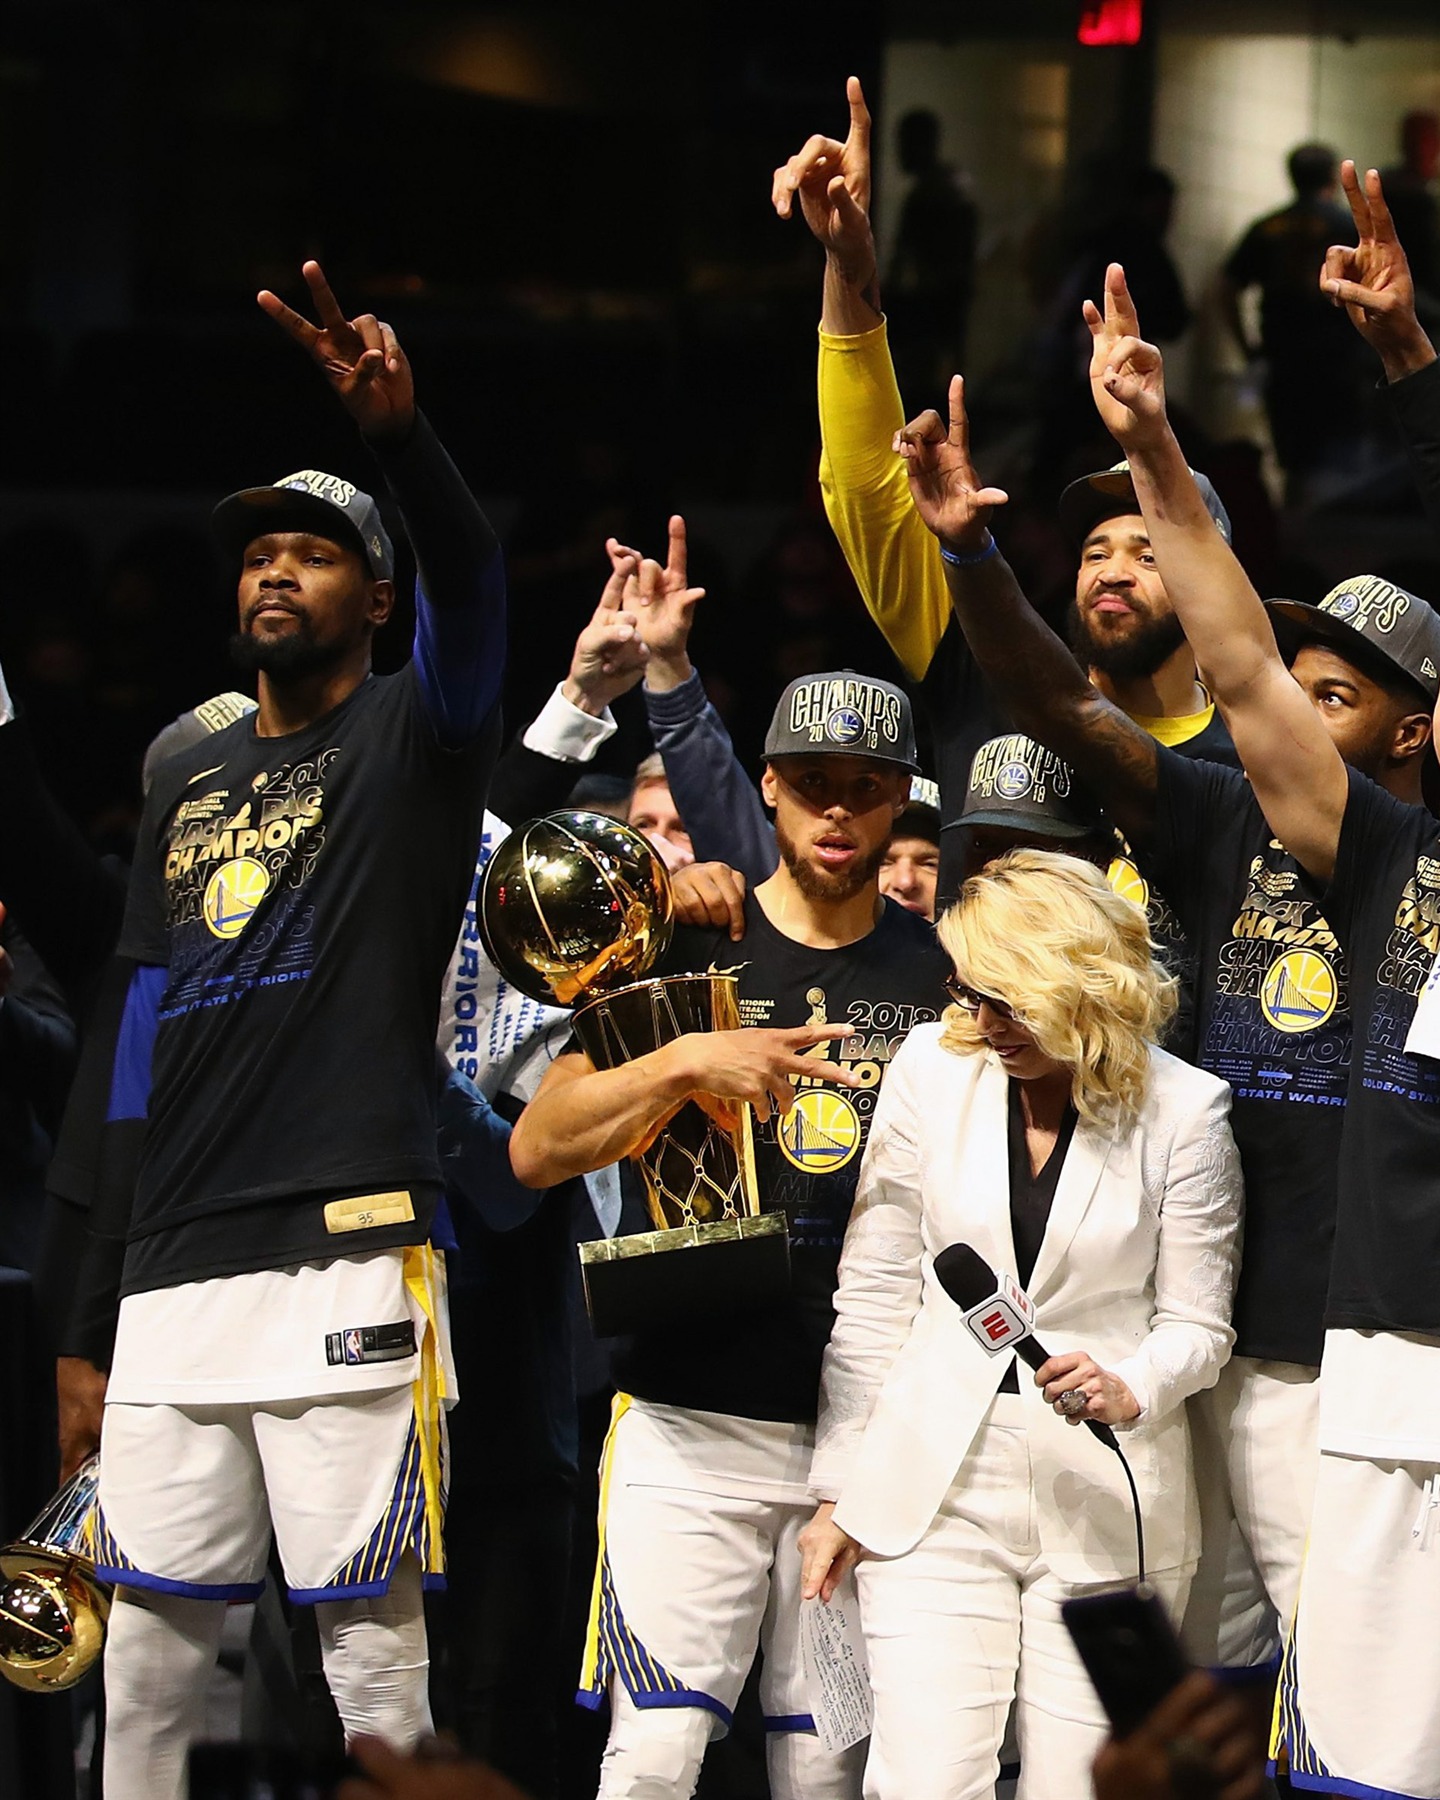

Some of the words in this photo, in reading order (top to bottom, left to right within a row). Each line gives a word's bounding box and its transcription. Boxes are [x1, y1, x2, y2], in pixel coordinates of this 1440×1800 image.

[790, 680, 901, 743] CHAMPS
[809, 725, 824, 742] 20
[867, 730, 878, 749] 18
[971, 735, 1073, 797] CHAMPS
[981, 781, 993, 798] 20
[1033, 785, 1046, 803] 18
[846, 1000, 937, 1030] 2018
[1238, 1088, 1283, 1101] STATE
[1288, 1092, 1348, 1107] WARRI
[358, 1212, 374, 1225] 35
